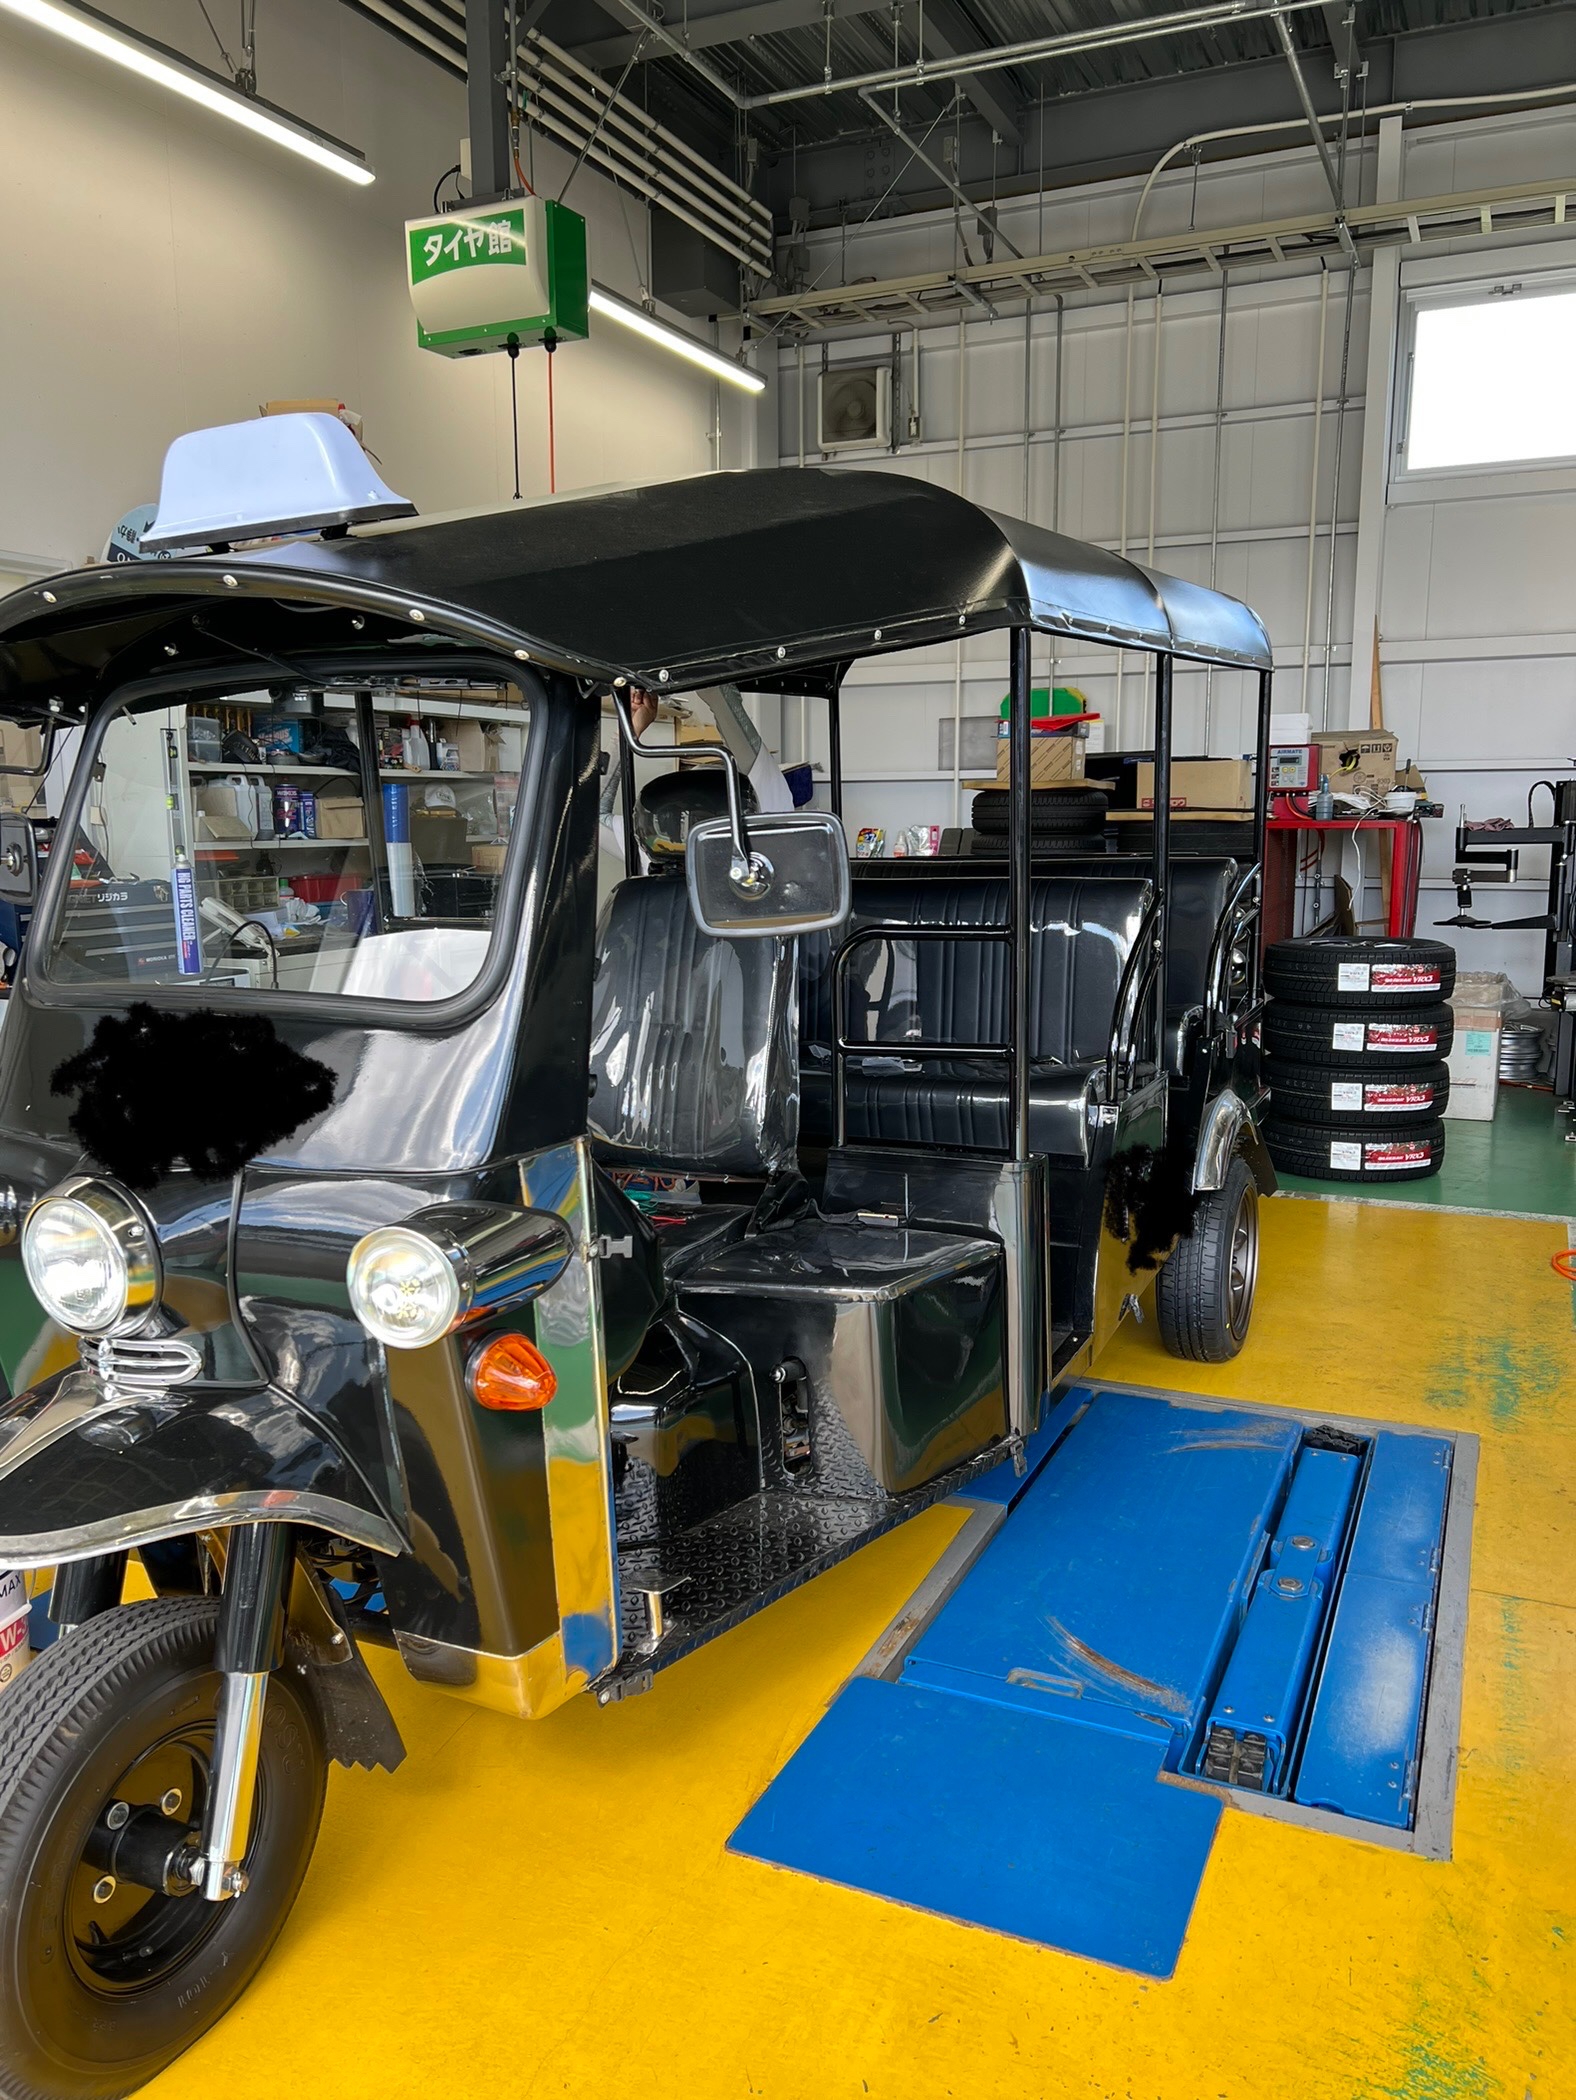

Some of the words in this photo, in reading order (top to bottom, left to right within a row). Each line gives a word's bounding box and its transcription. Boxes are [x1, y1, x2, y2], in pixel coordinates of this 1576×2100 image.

[423, 220, 511, 267] タイヤ館
[177, 872, 191, 883] HG
[97, 892, 128, 902] リジカラ
[178, 885, 194, 909] PARTS
[180, 909, 196, 941] CLEANER
[1413, 974, 1433, 983] VRX3
[1408, 1035, 1429, 1043] VRX3
[1405, 1152, 1424, 1161] VRX3
